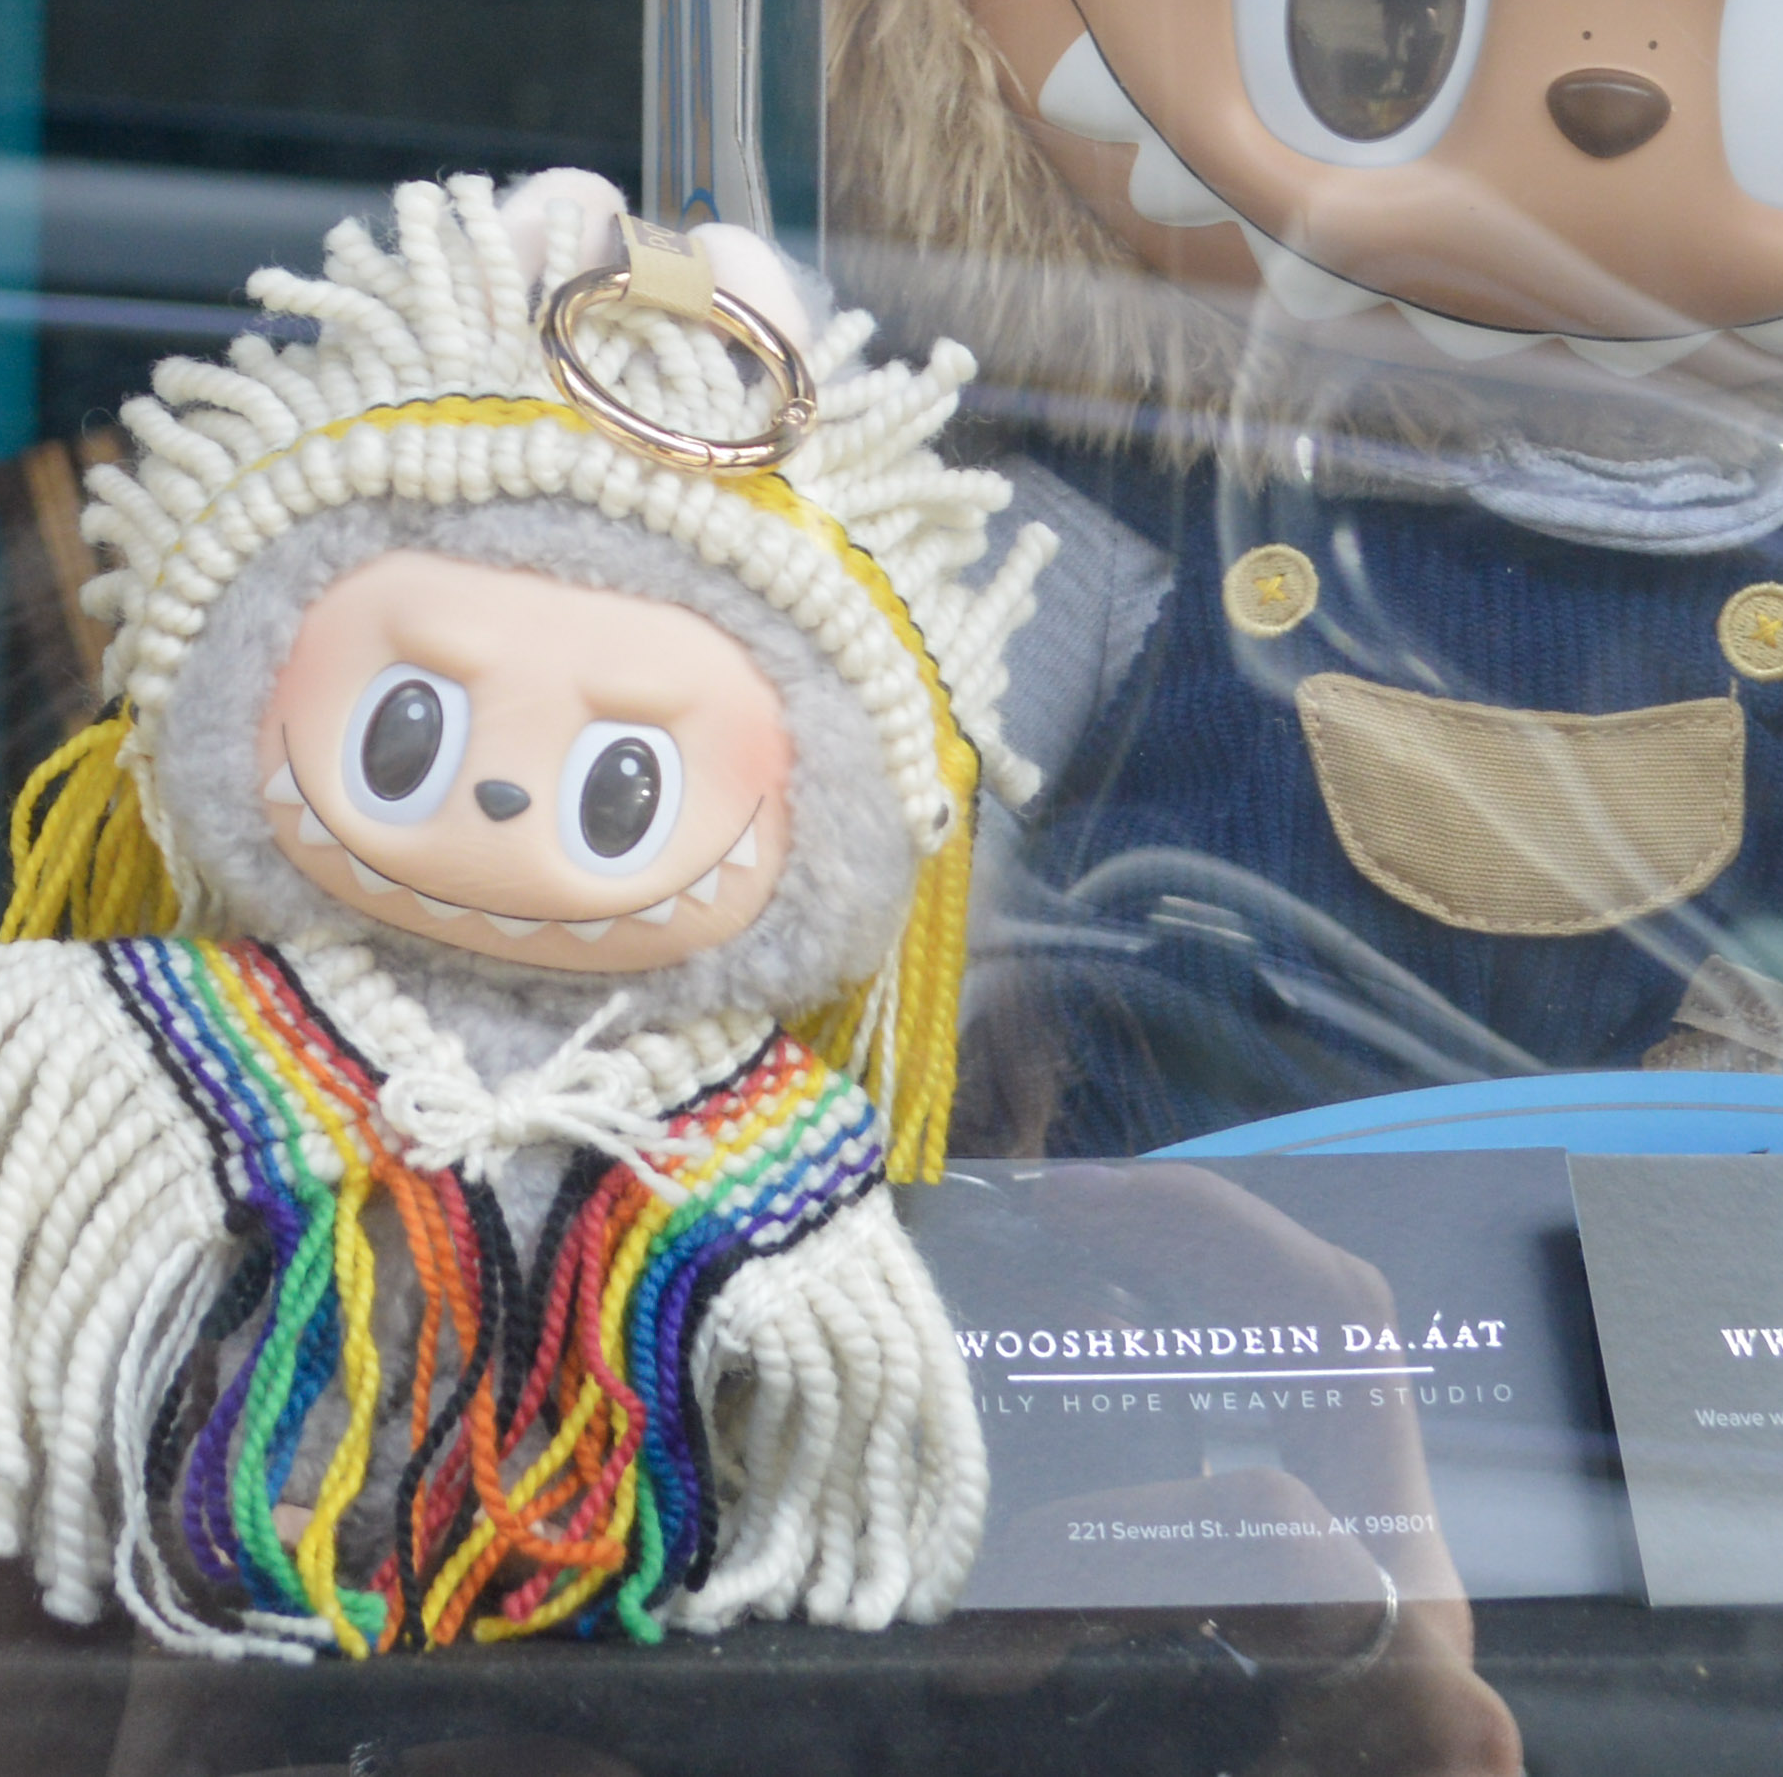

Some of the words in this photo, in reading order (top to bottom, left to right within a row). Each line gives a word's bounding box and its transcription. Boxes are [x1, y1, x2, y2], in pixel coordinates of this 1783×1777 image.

[954, 1325, 1320, 1358] WOOSHKINDEIN
[981, 1395, 1034, 1413] ILY
[1063, 1393, 1163, 1412] HOPE
[1189, 1389, 1343, 1411] WEAVER
[1370, 1384, 1513, 1407] STUDIO
[1695, 1408, 1765, 1428] Weave
[1068, 1522, 1105, 1541] 221
[1113, 1519, 1194, 1541] Seward
[1200, 1519, 1228, 1539] St.
[1329, 1516, 1359, 1535] AK
[1365, 1514, 1435, 1535] 99801
